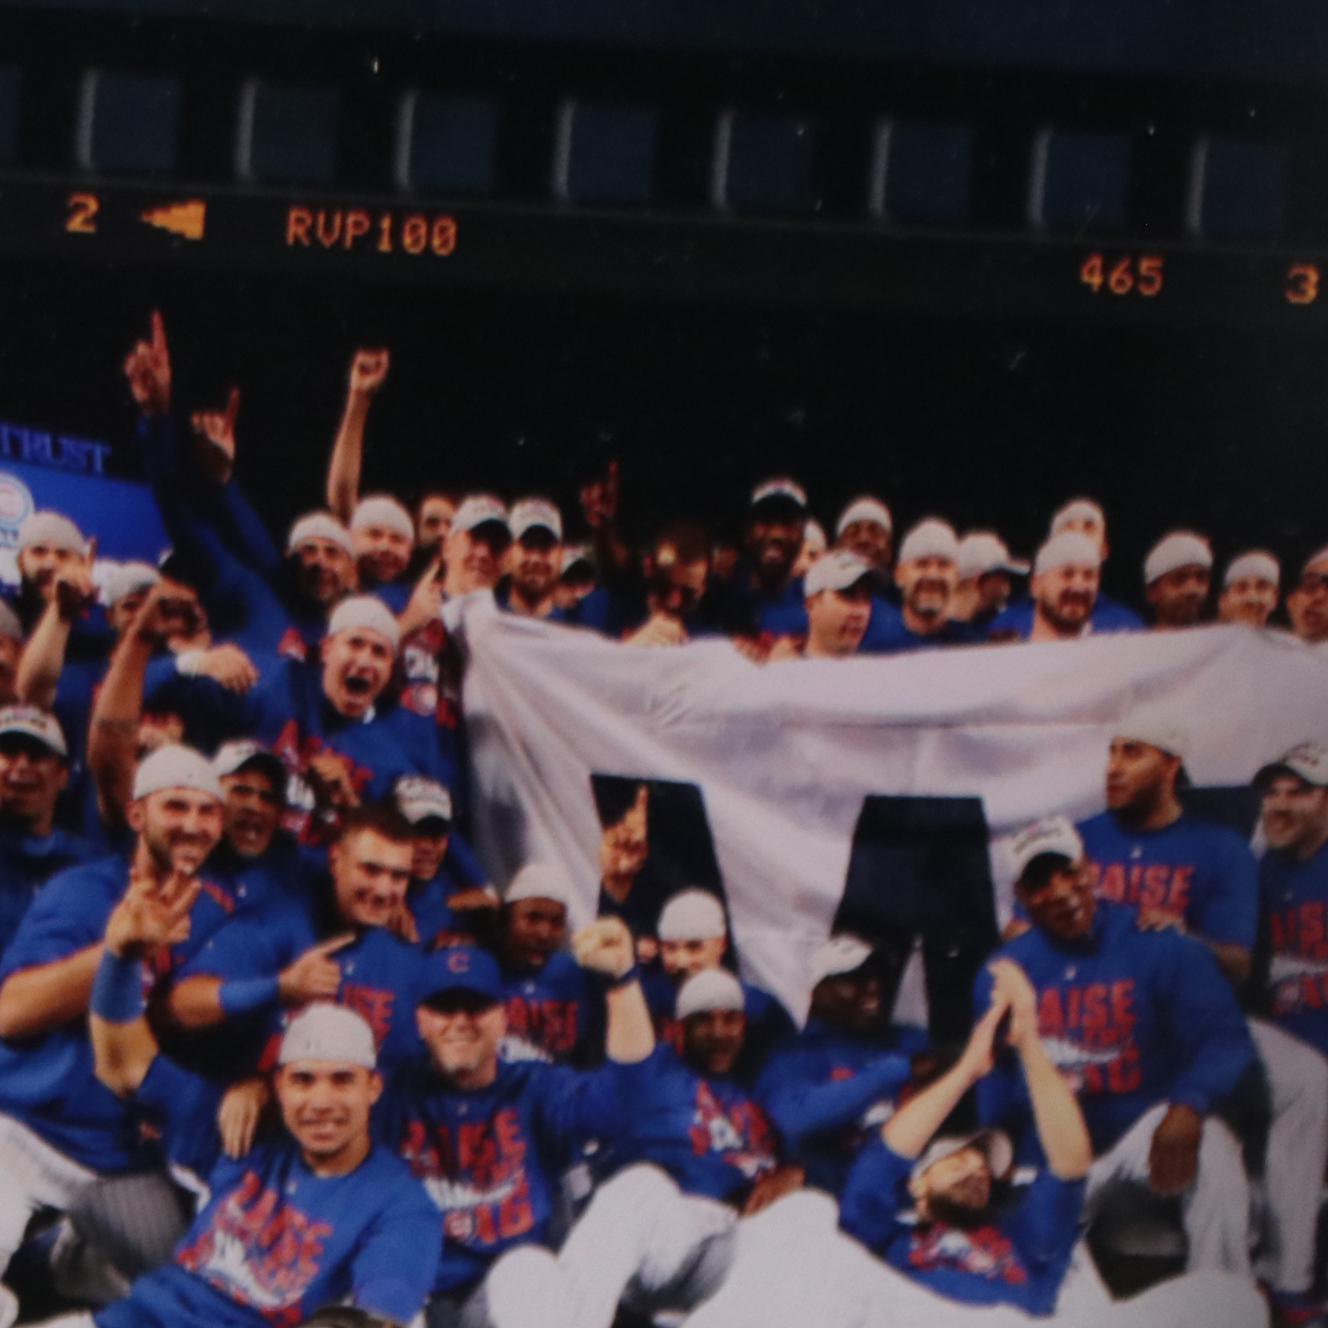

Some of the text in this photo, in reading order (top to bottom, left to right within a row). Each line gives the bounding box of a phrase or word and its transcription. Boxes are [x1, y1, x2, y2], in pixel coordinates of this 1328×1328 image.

[66, 192, 101, 233] 2
[286, 206, 459, 256] RVP100
[1079, 252, 1165, 297] 465
[1286, 264, 1321, 304] 3
[1037, 978, 1137, 1034] AISE
